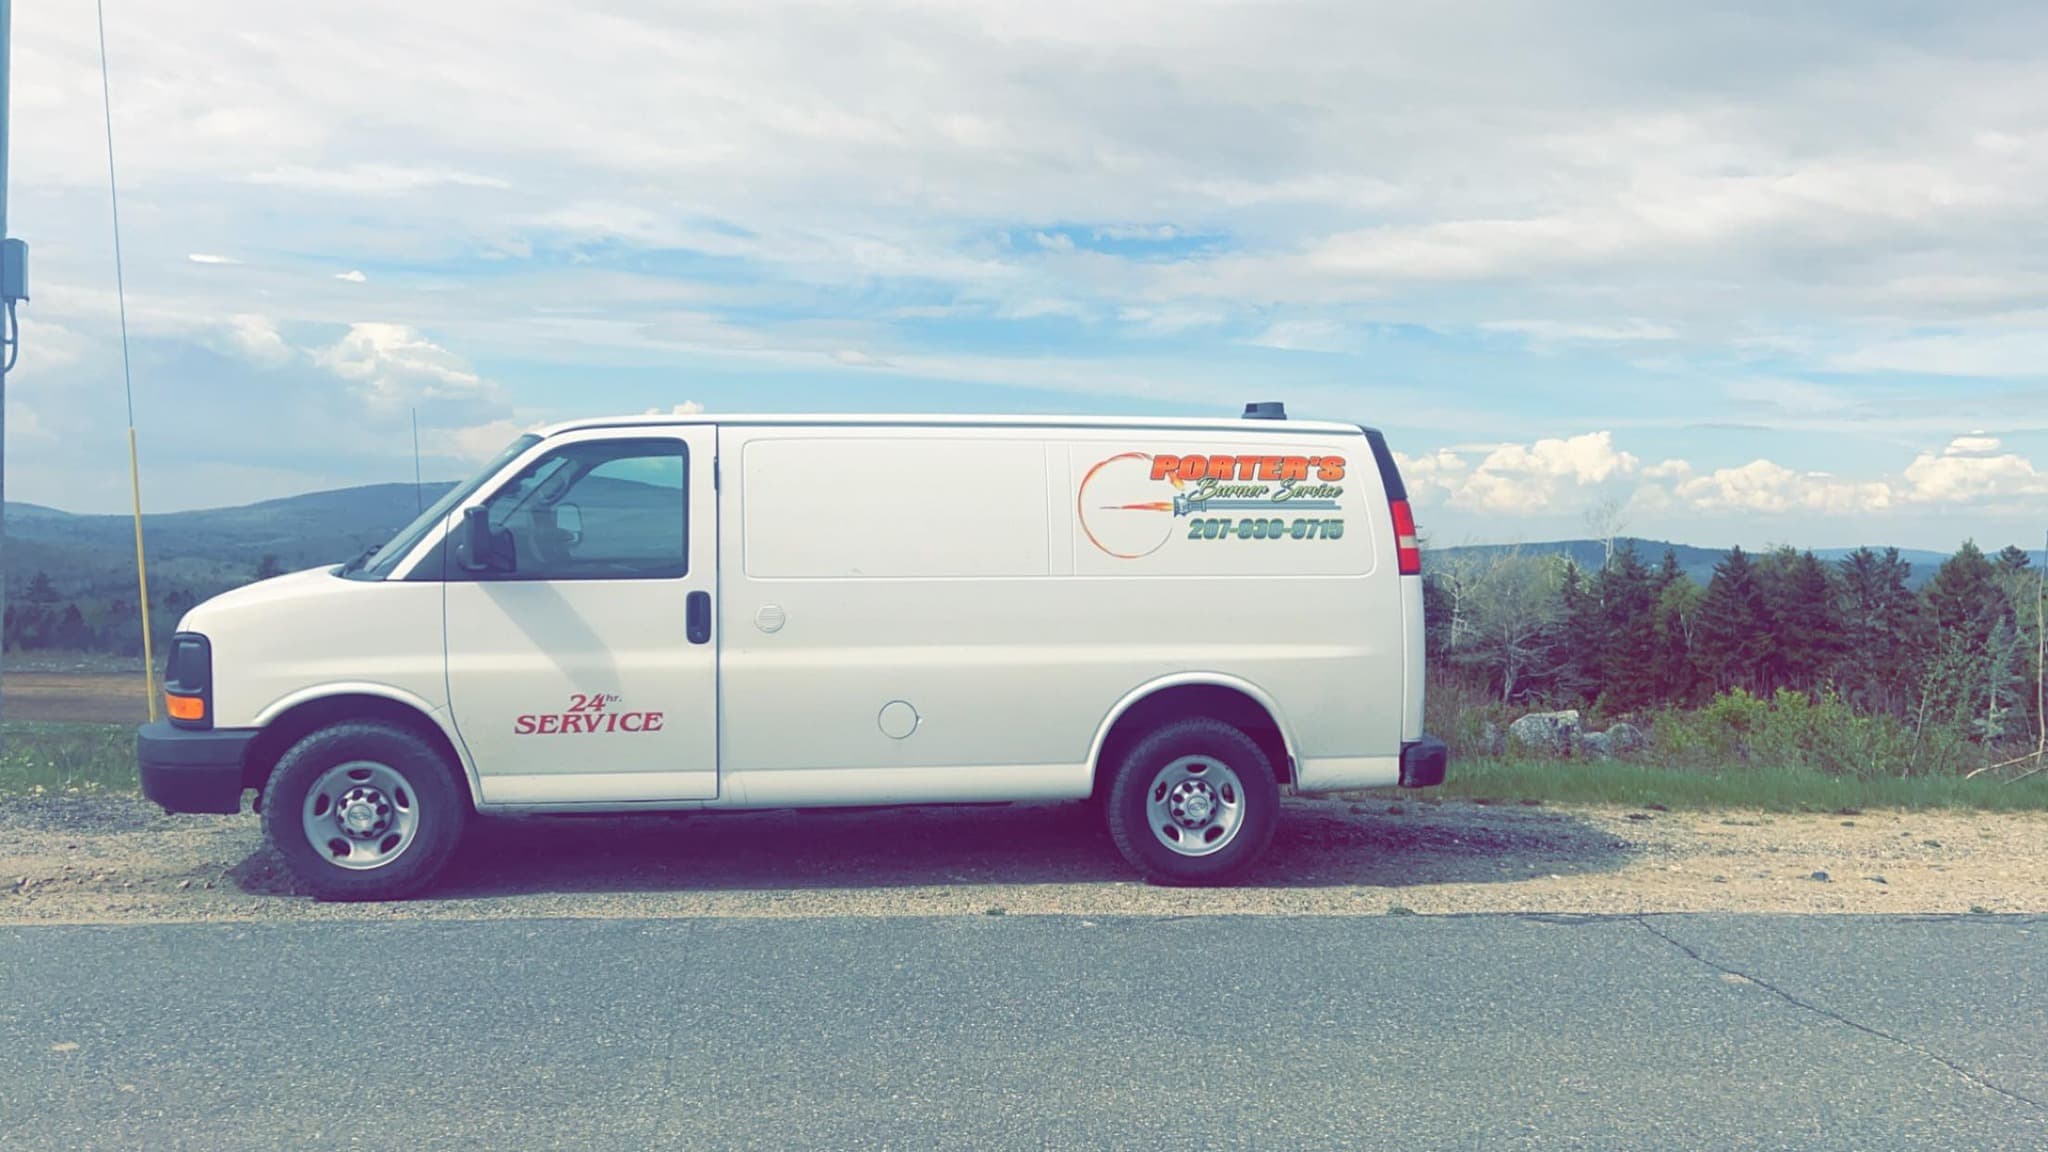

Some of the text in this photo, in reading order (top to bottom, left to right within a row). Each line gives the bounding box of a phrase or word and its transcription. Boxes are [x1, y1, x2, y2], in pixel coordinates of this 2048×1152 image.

[1150, 454, 1346, 481] PORTER'S
[1187, 476, 1344, 502] Burner Service
[514, 711, 664, 735] SERVICE
